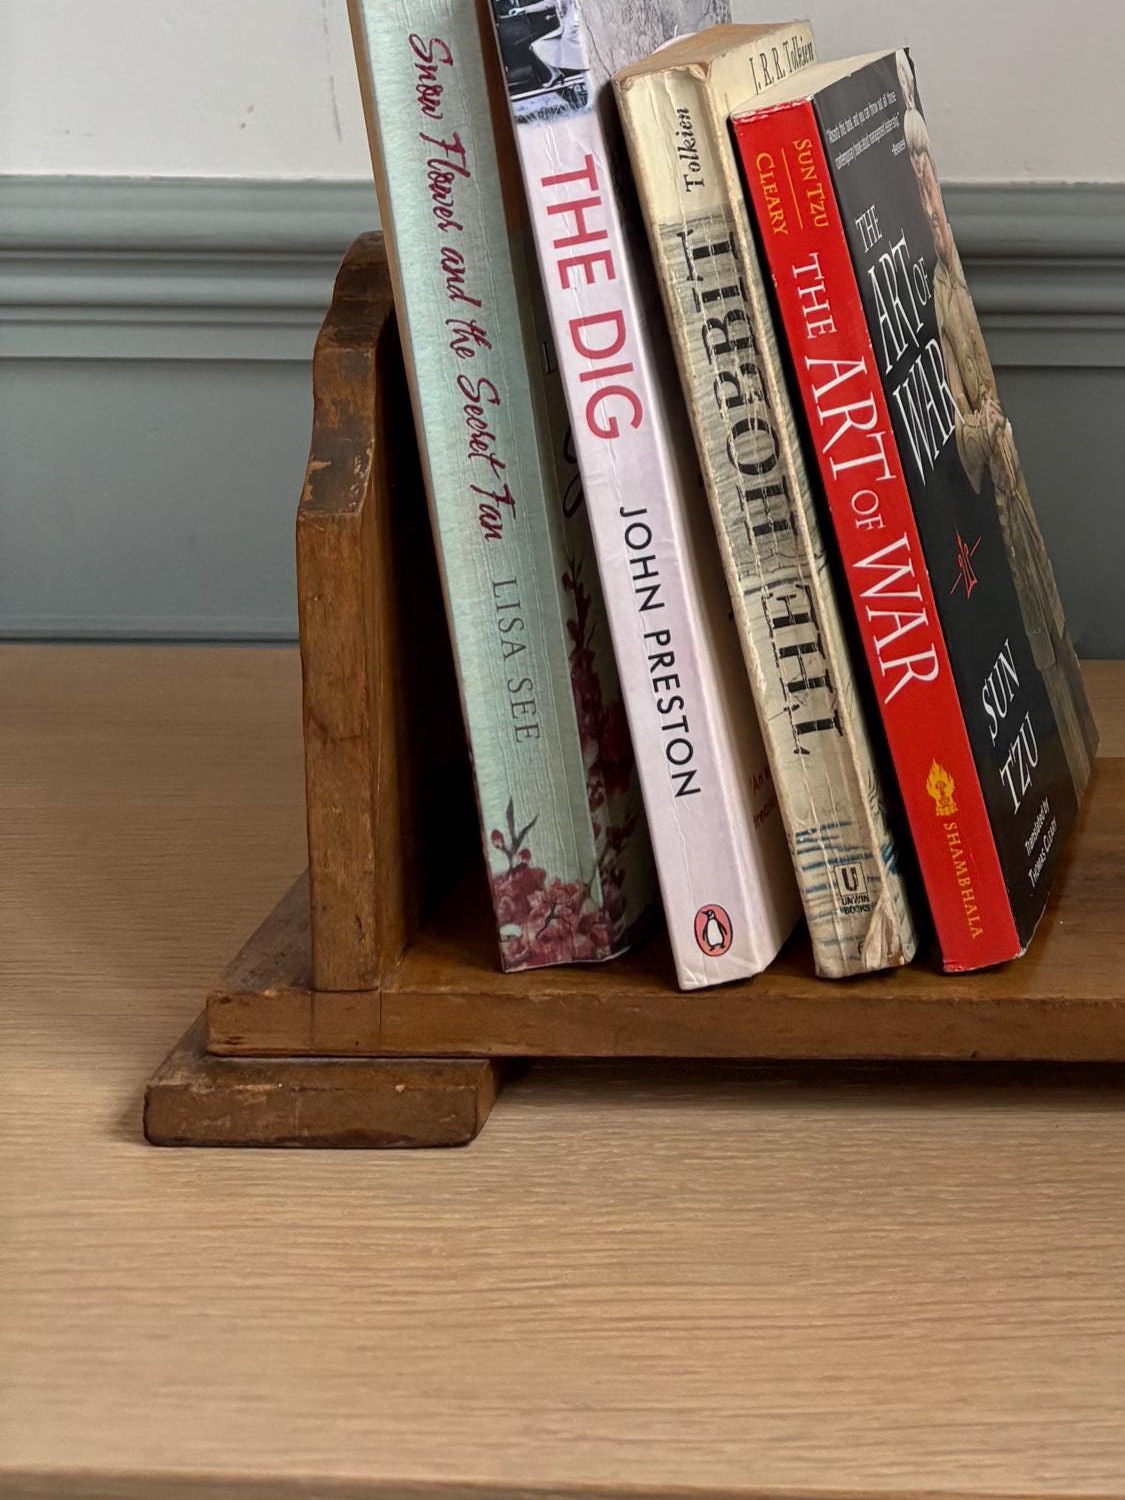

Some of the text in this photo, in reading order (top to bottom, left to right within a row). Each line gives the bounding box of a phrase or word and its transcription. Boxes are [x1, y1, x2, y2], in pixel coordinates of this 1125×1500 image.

[783, 35, 815, 74] Tolkien
[677, 107, 706, 192] Tolkien
[755, 152, 788, 236] CLEARY
[794, 138, 828, 228] SUN TZU
[855, 204, 883, 253] THE
[408, 33, 517, 542] Snow Flower and the Secret Fan
[540, 154, 643, 440] THE DIG
[868, 227, 931, 375] ART OF
[892, 338, 965, 488] WAR
[676, 229, 844, 755] THE HOBBIT
[792, 252, 940, 705] THE ART OF WAR
[491, 577, 541, 744] LISA SEE
[620, 506, 702, 798] JOHN PRESTON
[980, 638, 1021, 746] SUN
[1000, 712, 1040, 814] TZU
[841, 866, 859, 891] U
[844, 904, 871, 915] BOOKS
[944, 821, 985, 940] SHAMBHALA
